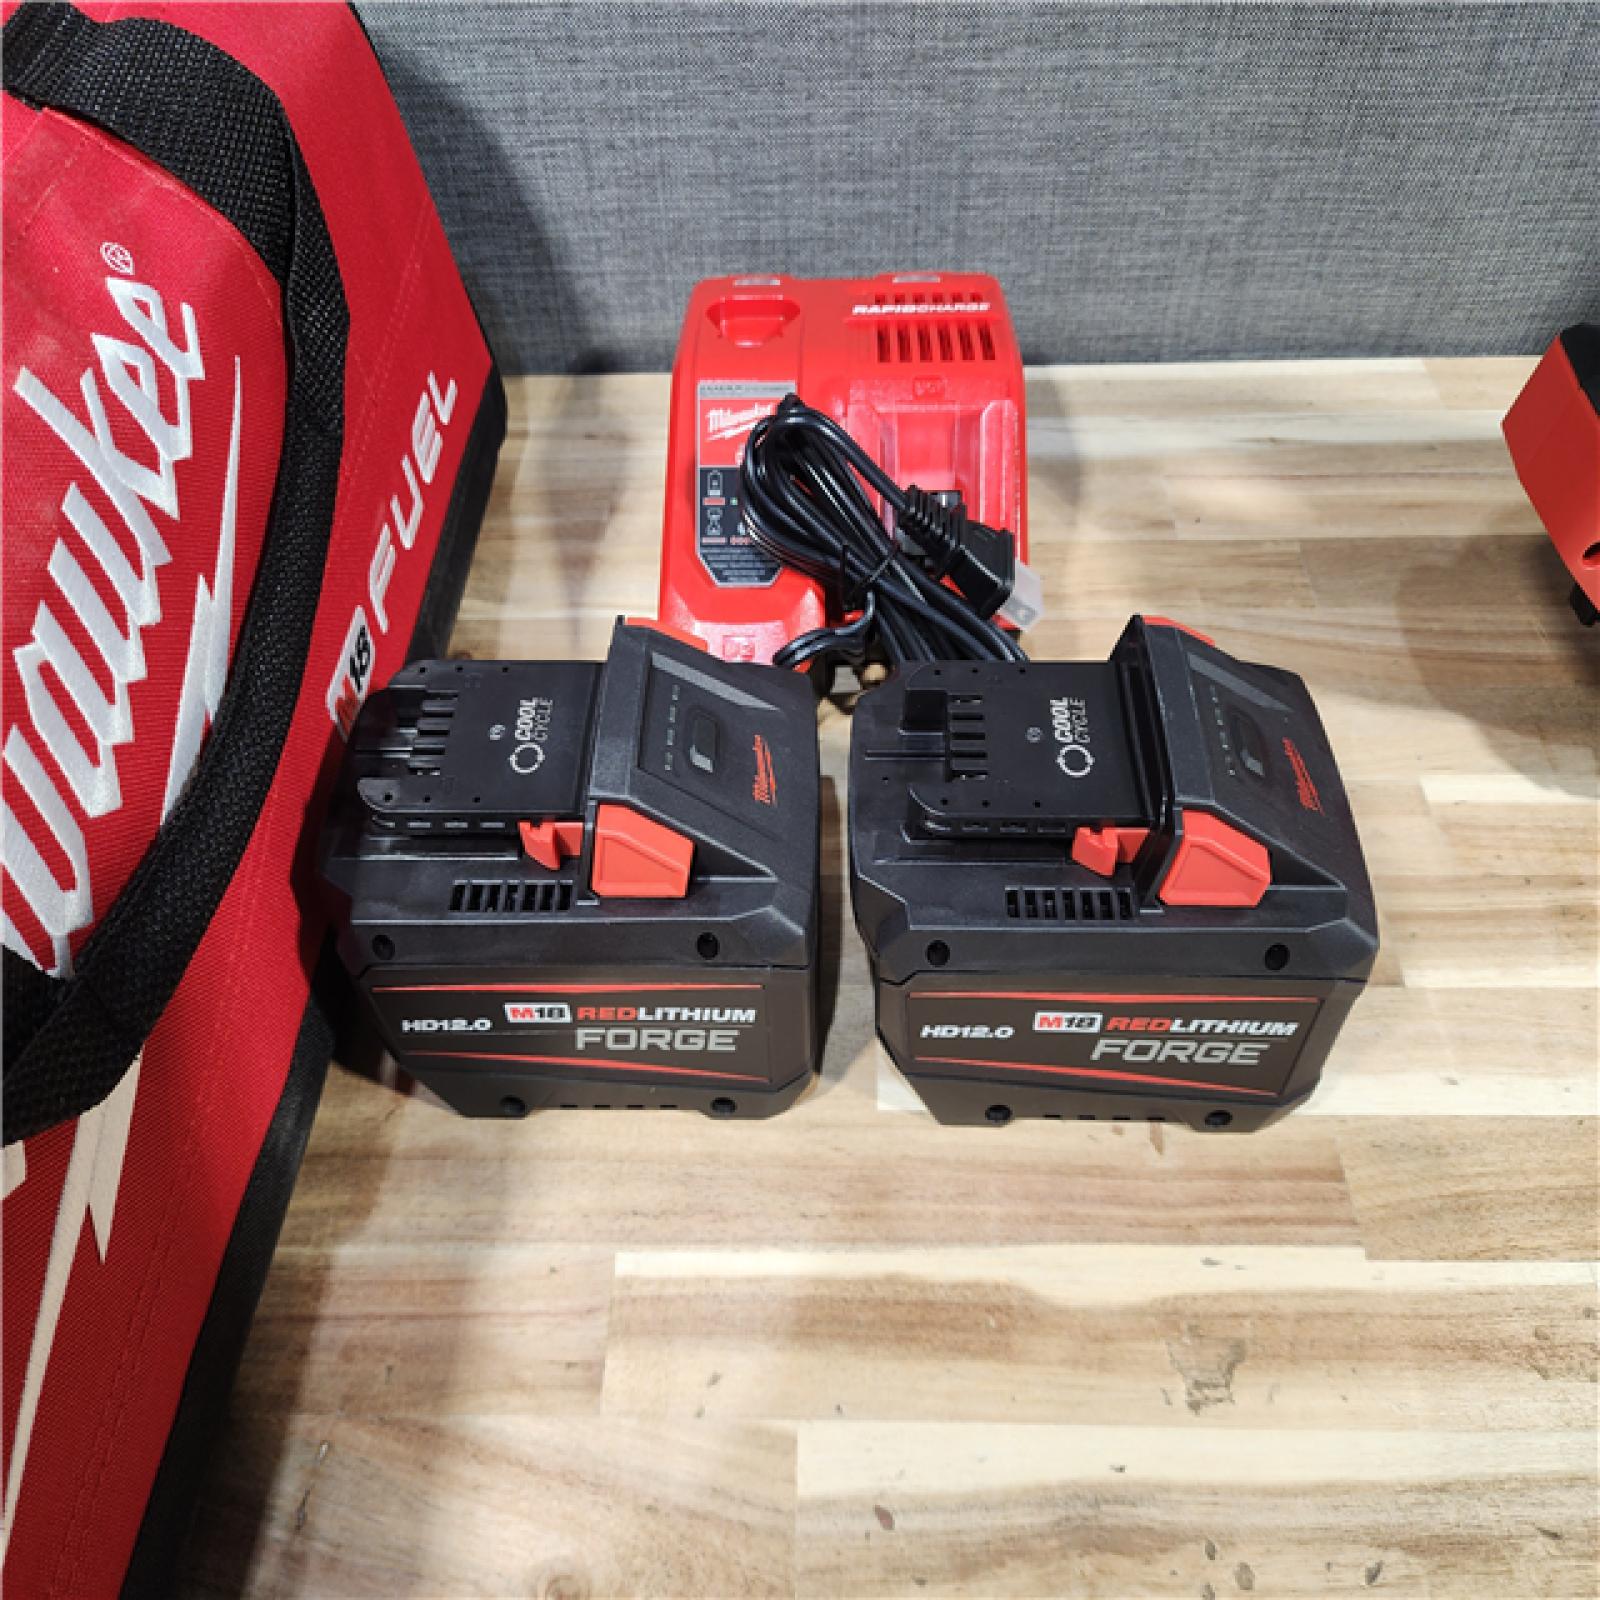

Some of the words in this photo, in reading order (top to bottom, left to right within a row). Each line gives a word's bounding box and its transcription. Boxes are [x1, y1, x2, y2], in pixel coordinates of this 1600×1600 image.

[369, 370, 457, 634] FUEL
[514, 698, 536, 741] COOL
[1050, 697, 1074, 743] COOL
[401, 1018, 493, 1033] HD12.0
[506, 1003, 570, 1022] M18
[576, 1006, 757, 1024] REDLITHIUM
[1035, 1013, 1101, 1032] M18
[1106, 1016, 1299, 1037] REDLITHIUM
[574, 1028, 741, 1052] FORGE
[919, 1024, 1016, 1039] HD12.0
[1089, 1039, 1271, 1065] FORGE
